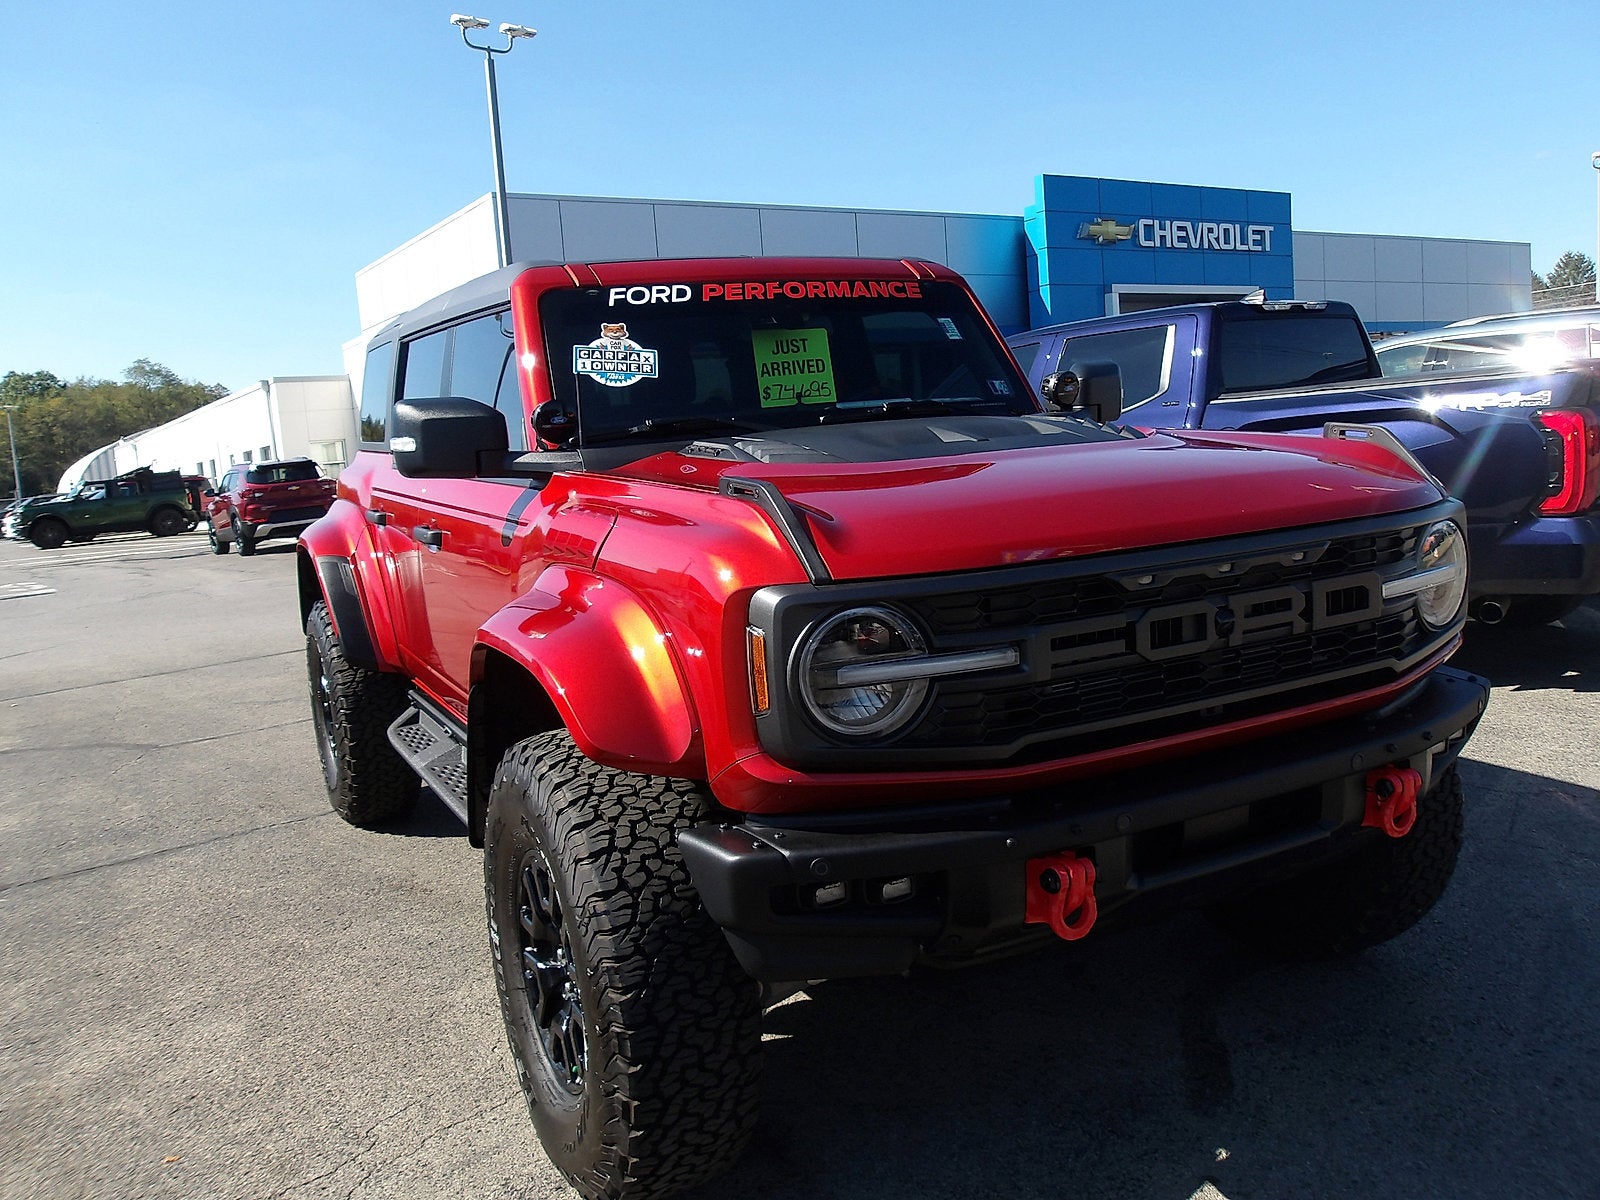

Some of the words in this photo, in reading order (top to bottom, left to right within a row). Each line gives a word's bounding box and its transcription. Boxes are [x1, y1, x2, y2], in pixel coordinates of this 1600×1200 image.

[1138, 218, 1274, 251] CHEVROLET
[608, 284, 692, 306] FORD
[702, 281, 922, 301] PERFORMANCE
[579, 350, 651, 363] CARFAX
[771, 338, 808, 355] JUST
[760, 358, 826, 377] ARRIVED
[1039, 571, 1383, 681] FORD
